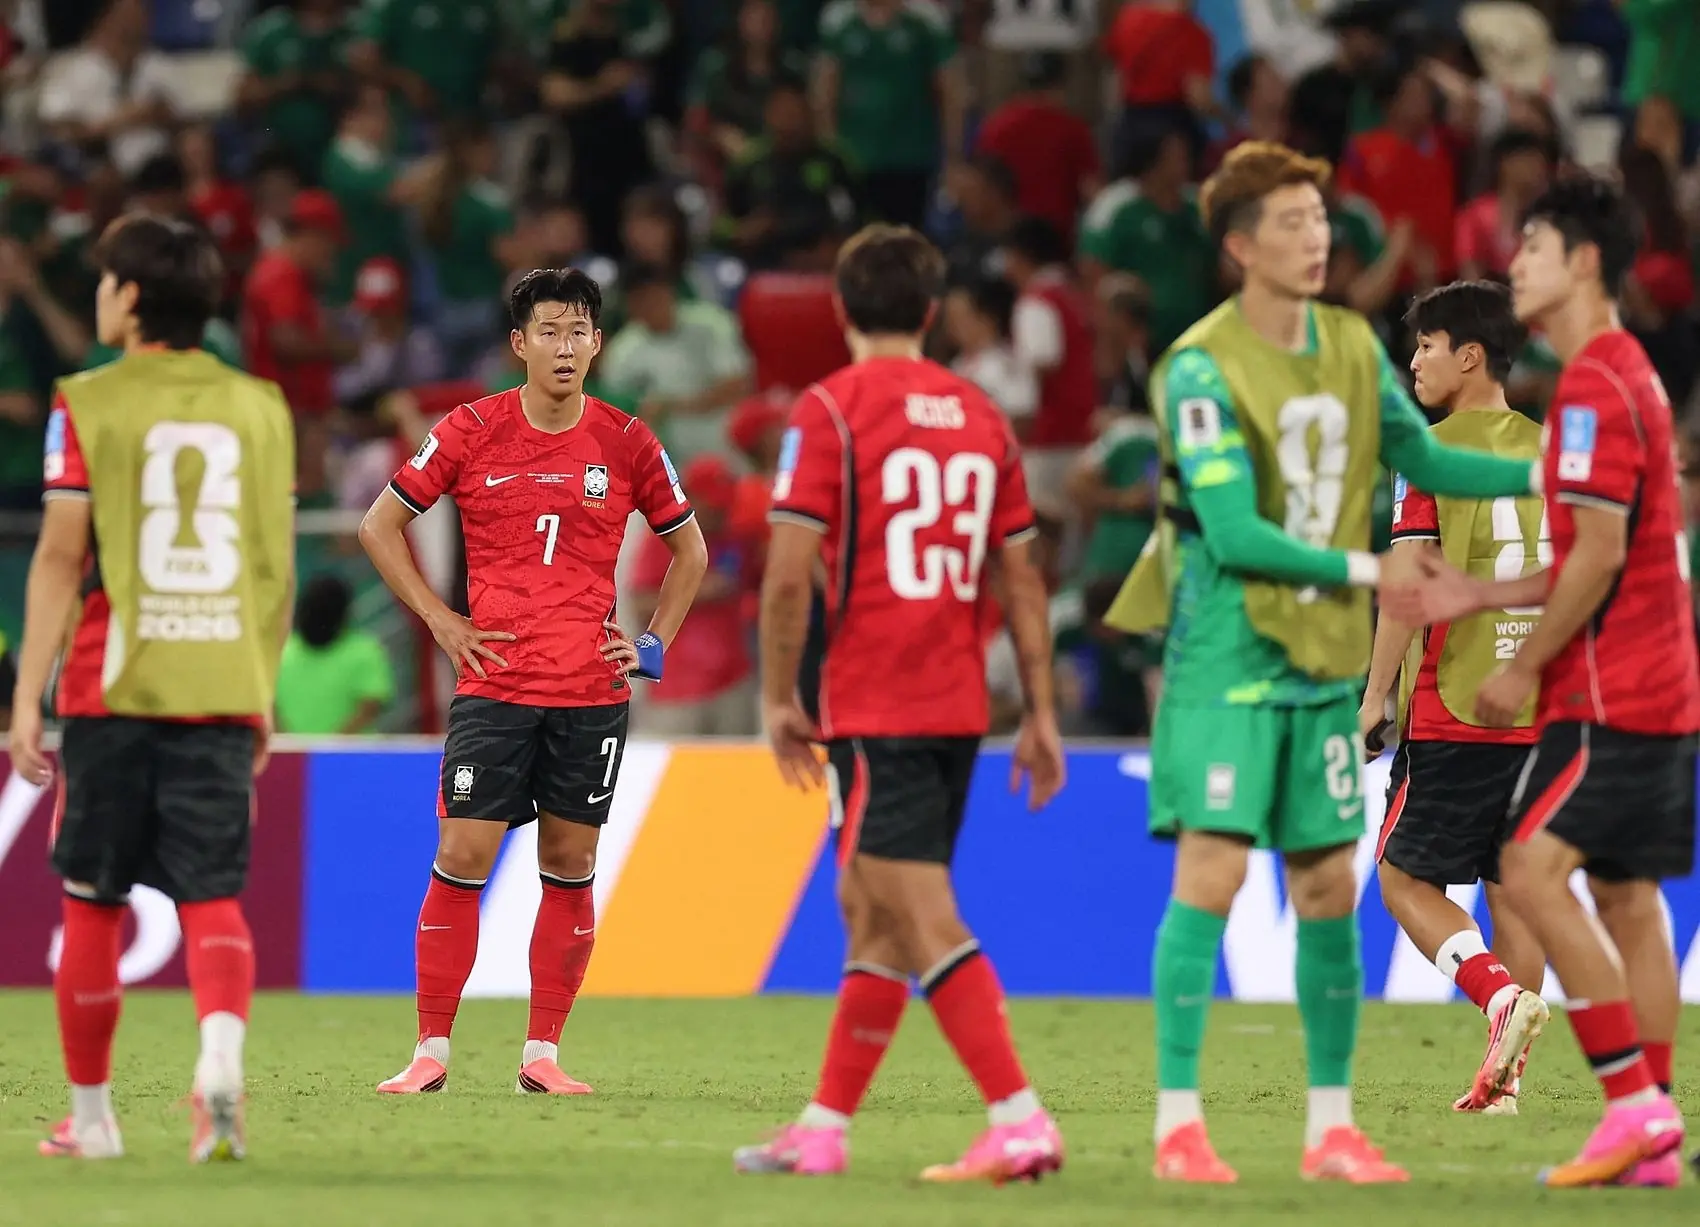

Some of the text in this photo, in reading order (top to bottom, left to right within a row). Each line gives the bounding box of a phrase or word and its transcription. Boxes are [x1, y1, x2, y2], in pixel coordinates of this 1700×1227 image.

[582, 499, 605, 509] KOREA
[881, 446, 998, 602] 23
[535, 513, 560, 566] 7
[600, 736, 618, 788] 7
